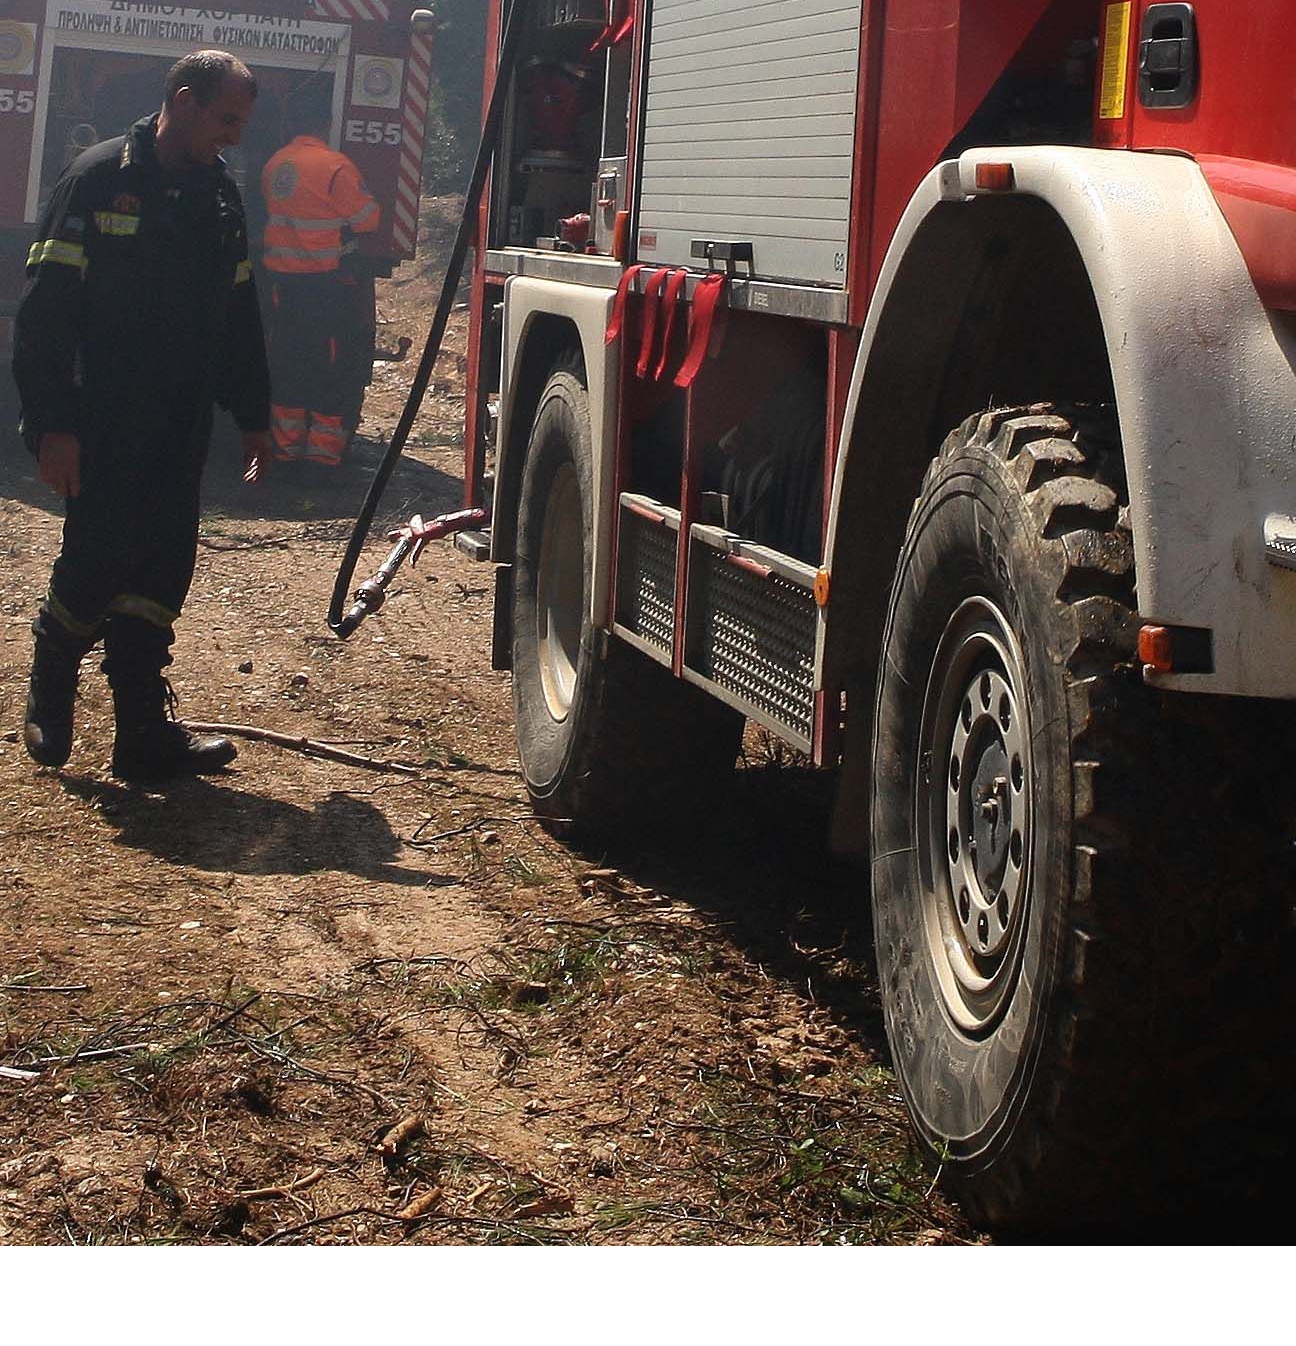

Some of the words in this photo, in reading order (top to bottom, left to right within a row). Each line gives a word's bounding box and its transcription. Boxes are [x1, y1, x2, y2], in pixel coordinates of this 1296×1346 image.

[58, 10, 112, 33] ΠΡΟΛΗΨΗ
[114, 16, 121, 33] &
[345, 119, 402, 145] E55
